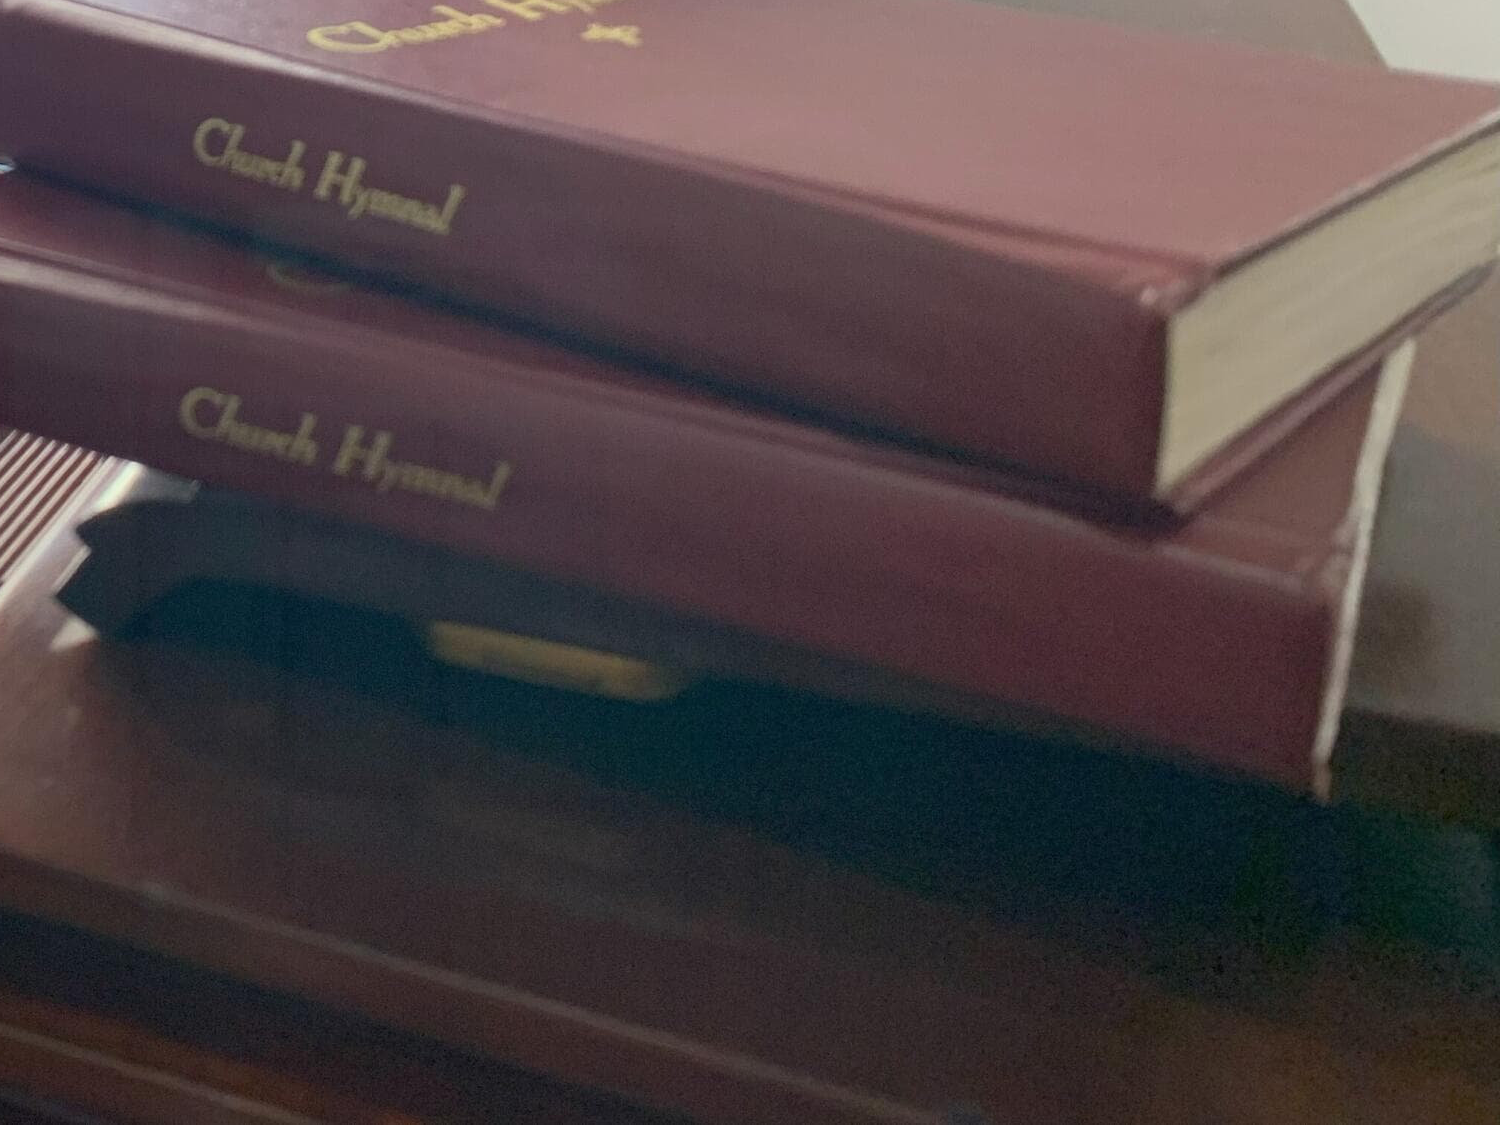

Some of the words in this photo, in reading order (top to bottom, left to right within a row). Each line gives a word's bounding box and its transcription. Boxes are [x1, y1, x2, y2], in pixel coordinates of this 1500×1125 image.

[306, 5, 506, 54] Church
[192, 117, 307, 192] Church
[313, 149, 467, 236] Hymnal
[179, 386, 319, 466] Church
[332, 424, 516, 512] Hymnal
